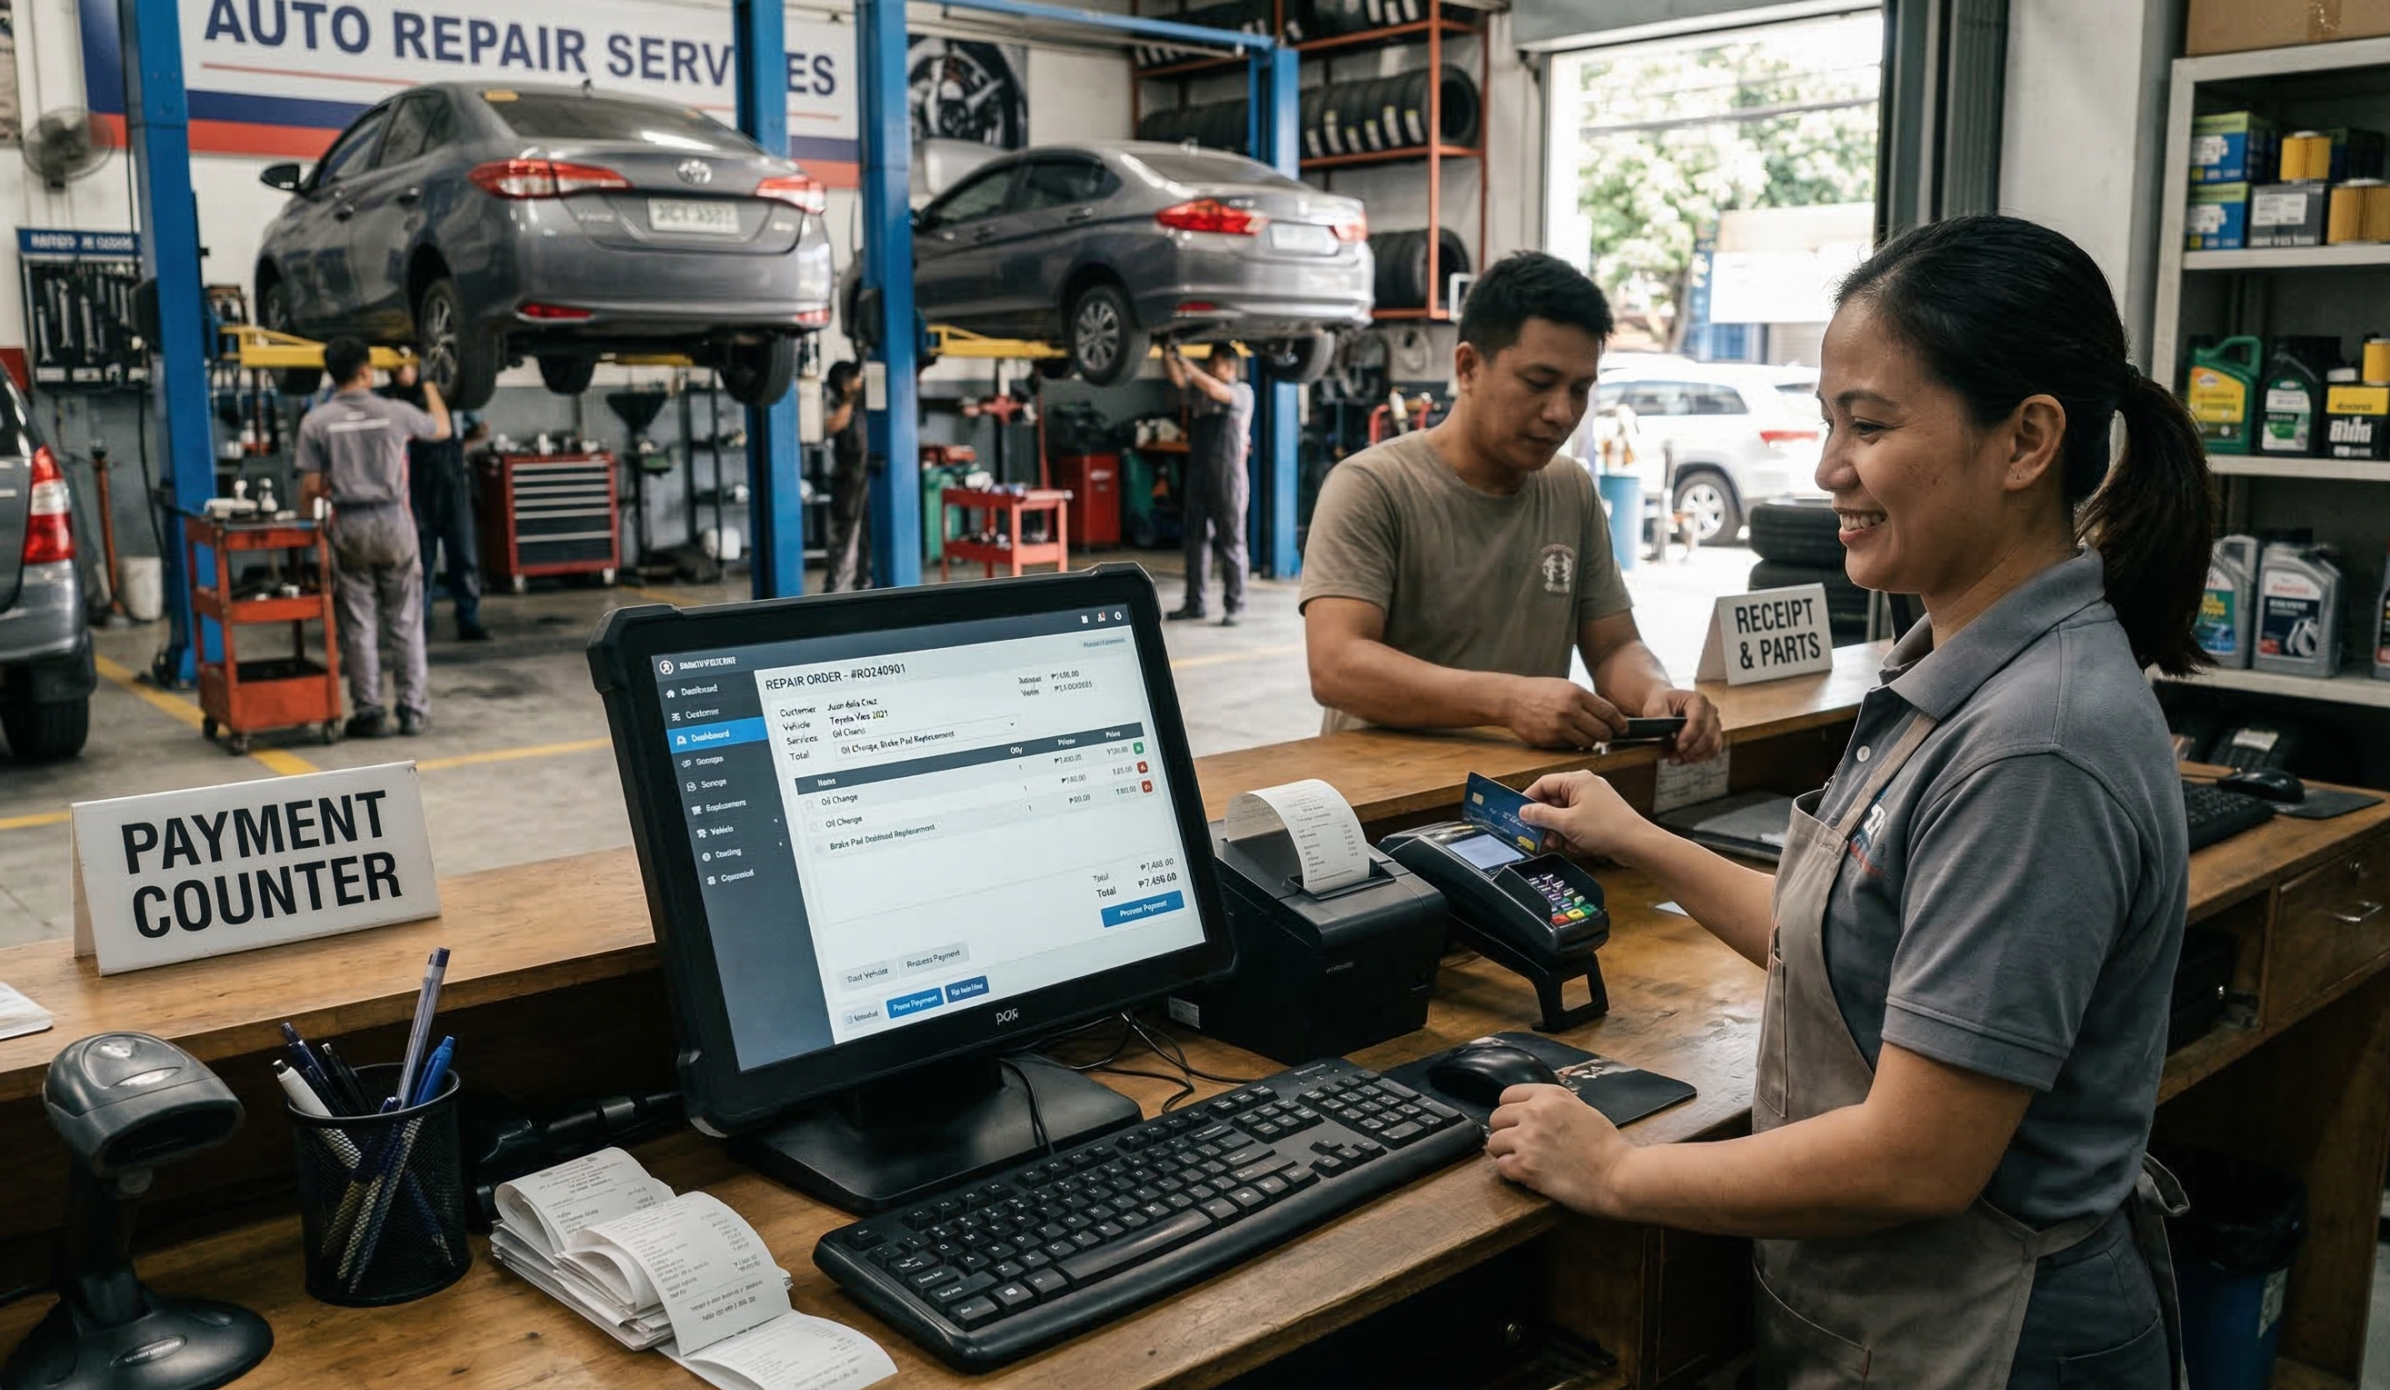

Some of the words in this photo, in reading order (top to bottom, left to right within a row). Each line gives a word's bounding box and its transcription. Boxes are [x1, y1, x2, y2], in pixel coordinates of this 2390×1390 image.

[204, 0, 371, 54] AUTO
[393, 11, 587, 74] REPAIR
[1735, 598, 1813, 634] RECEIPT
[1740, 641, 1754, 670] &
[1760, 632, 1821, 667] PARTS
[765, 676, 805, 690] REPAIR
[807, 671, 842, 685] ORDER
[851, 664, 906, 679] #RO240901
[789, 750, 810, 761] Total
[832, 794, 858, 804] Change
[121, 789, 387, 875] PAYMENT
[132, 851, 403, 939] COUNTER
[1096, 886, 1117, 898] Total
